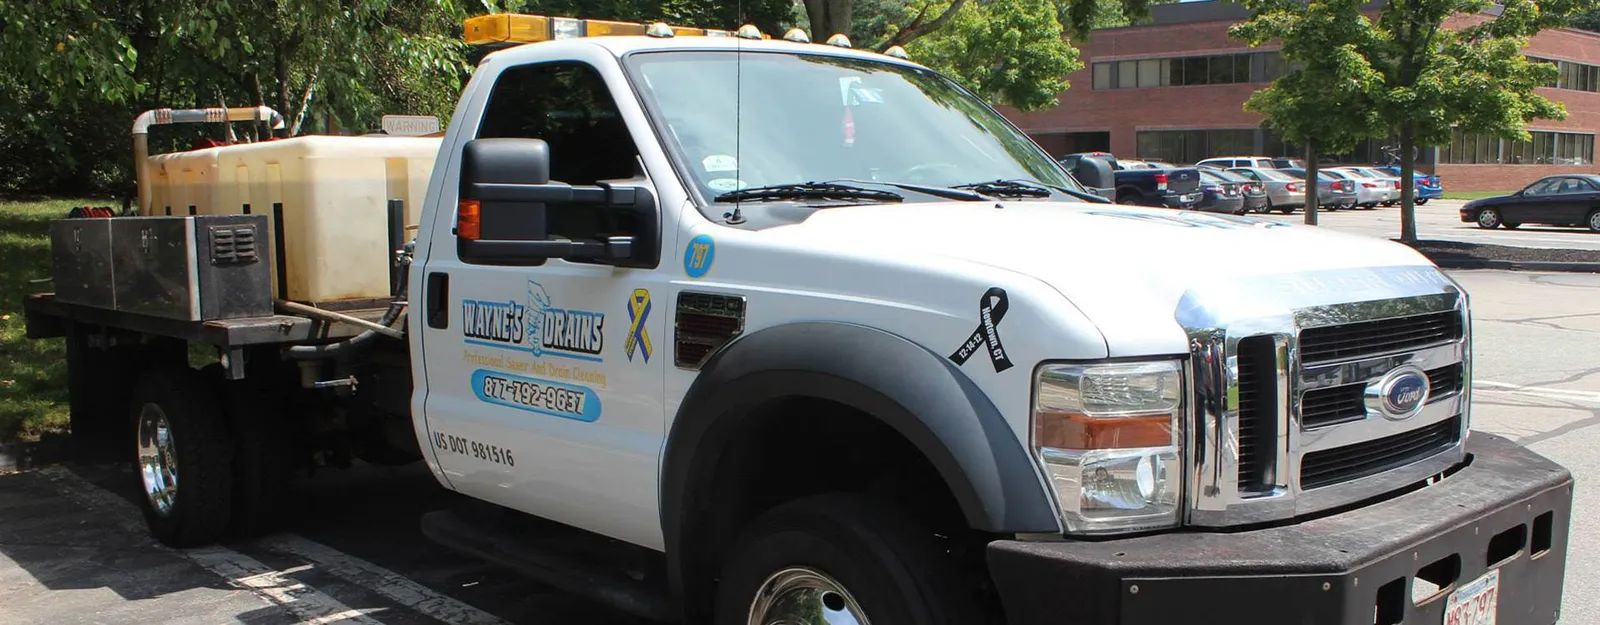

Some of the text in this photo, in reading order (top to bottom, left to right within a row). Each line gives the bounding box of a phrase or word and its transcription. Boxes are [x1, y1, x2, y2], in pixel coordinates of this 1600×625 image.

[386, 120, 436, 132] WARNING
[689, 243, 710, 268] 797
[463, 300, 524, 343] WAYNE'S
[543, 308, 604, 355] DRAINS
[959, 333, 983, 359] 12-14-12
[484, 376, 586, 414] 877-792-9637
[1397, 387, 1423, 404] Ford
[433, 431, 514, 467] US DOT 981516
